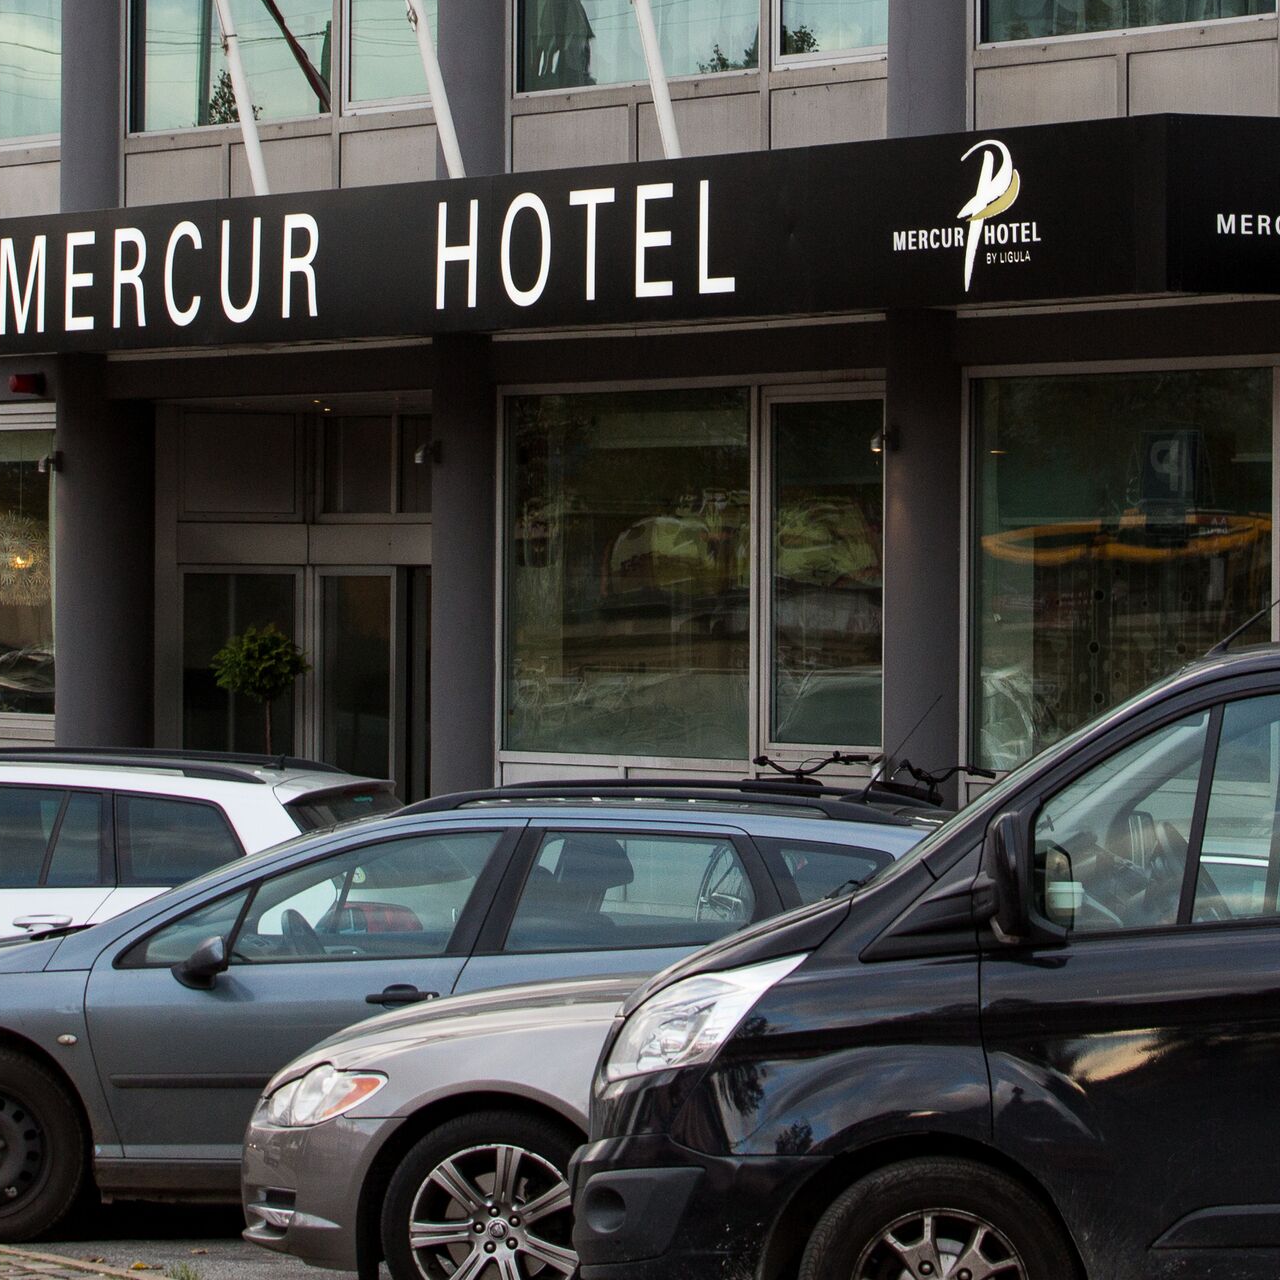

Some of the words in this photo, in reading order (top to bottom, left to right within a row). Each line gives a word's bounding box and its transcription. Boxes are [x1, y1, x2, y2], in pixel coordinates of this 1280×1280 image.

[435, 178, 736, 311] HOTEL
[894, 227, 963, 251] MERCUR
[985, 222, 1041, 244] HOTEL
[987, 253, 996, 264] BY
[1000, 251, 1030, 263] LIGULA
